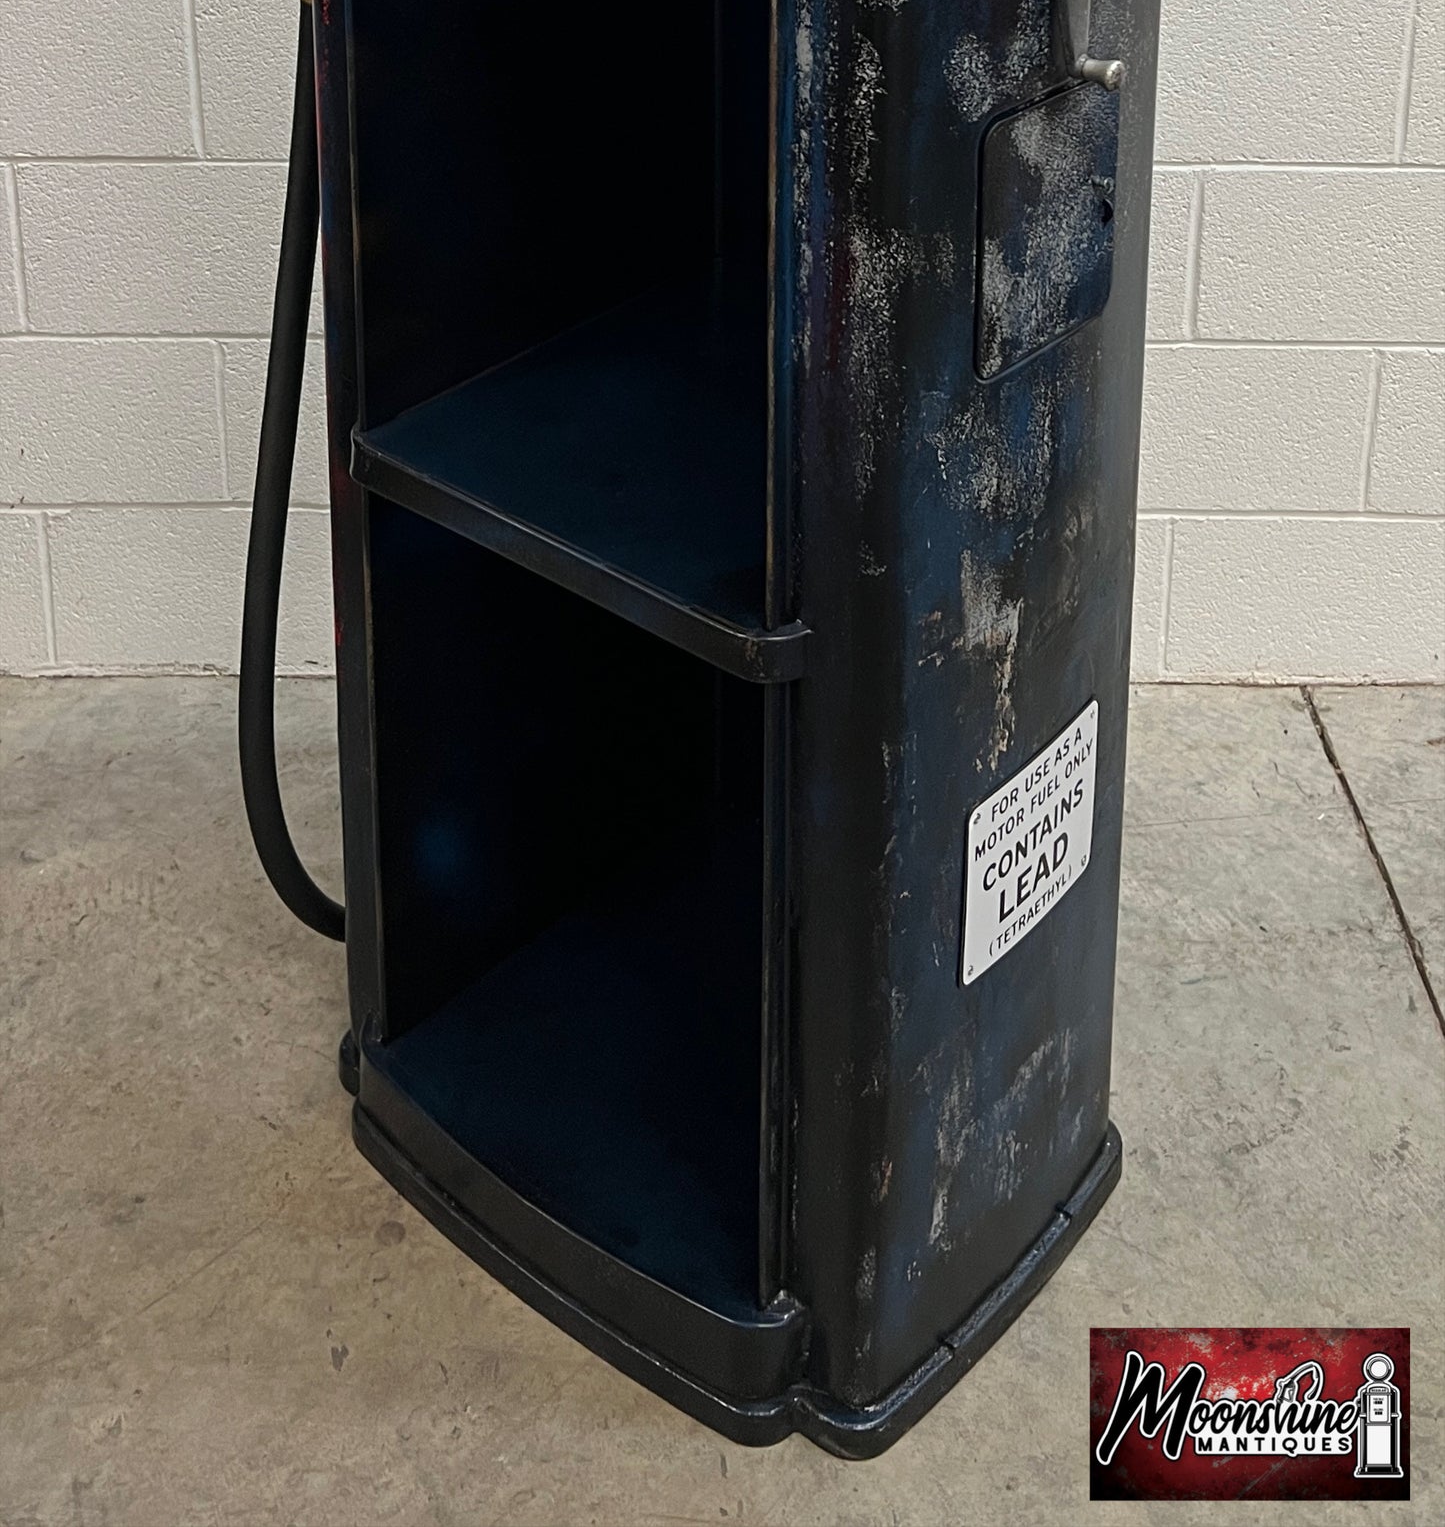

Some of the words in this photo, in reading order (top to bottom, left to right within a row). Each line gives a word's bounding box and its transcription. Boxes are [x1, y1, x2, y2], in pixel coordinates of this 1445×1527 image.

[974, 809, 1025, 862] MOTOR
[1030, 775, 1060, 815] FUEL
[1064, 737, 1094, 779] ONLY
[991, 787, 1019, 823] FOR
[1024, 761, 1051, 794] USE
[1054, 744, 1070, 768] AS
[1074, 727, 1082, 748] A
[982, 778, 1084, 892] CONTAINS
[999, 832, 1069, 924] LEAD
[988, 863, 1072, 957] (TETRAETHYL)
